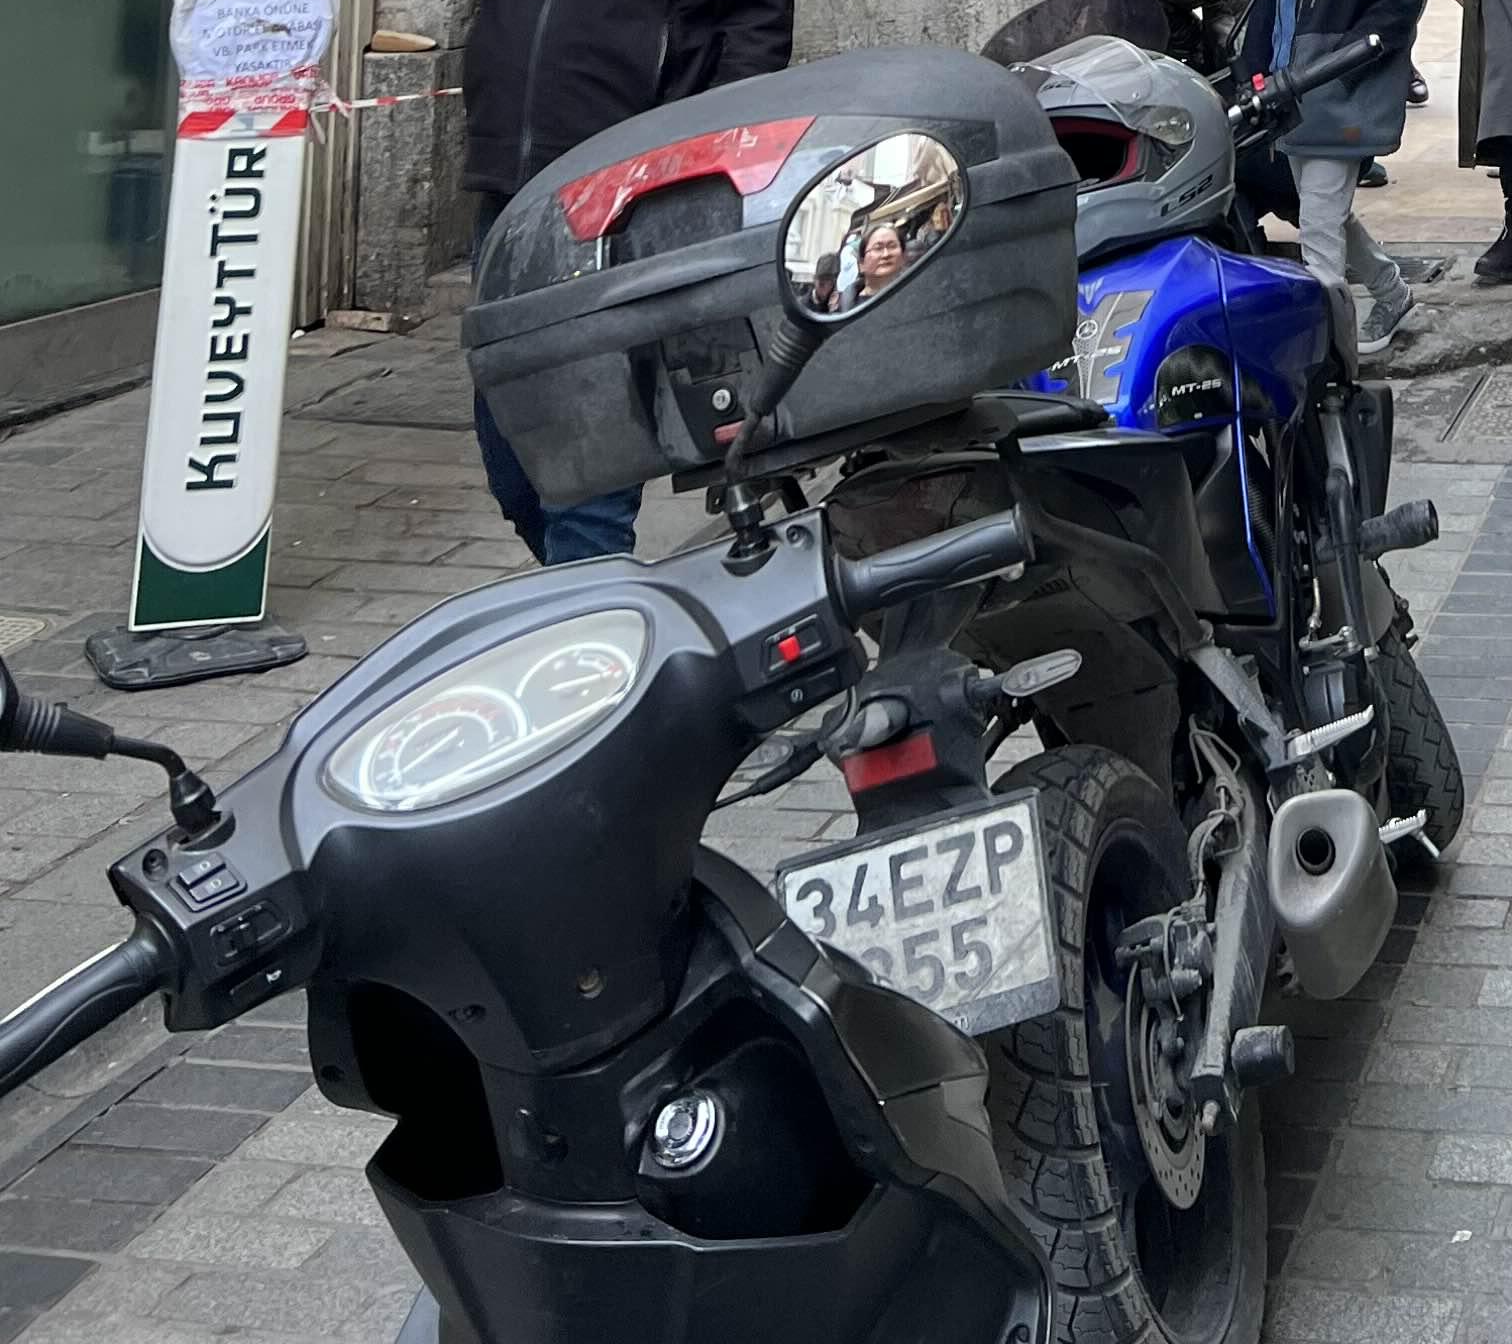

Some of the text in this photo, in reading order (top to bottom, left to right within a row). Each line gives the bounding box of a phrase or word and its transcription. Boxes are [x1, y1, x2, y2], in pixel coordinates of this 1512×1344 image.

[1160, 173, 1215, 218] LS2
[186, 144, 268, 492] KUVEYTTÜR
[1171, 378, 1223, 398] MT-25
